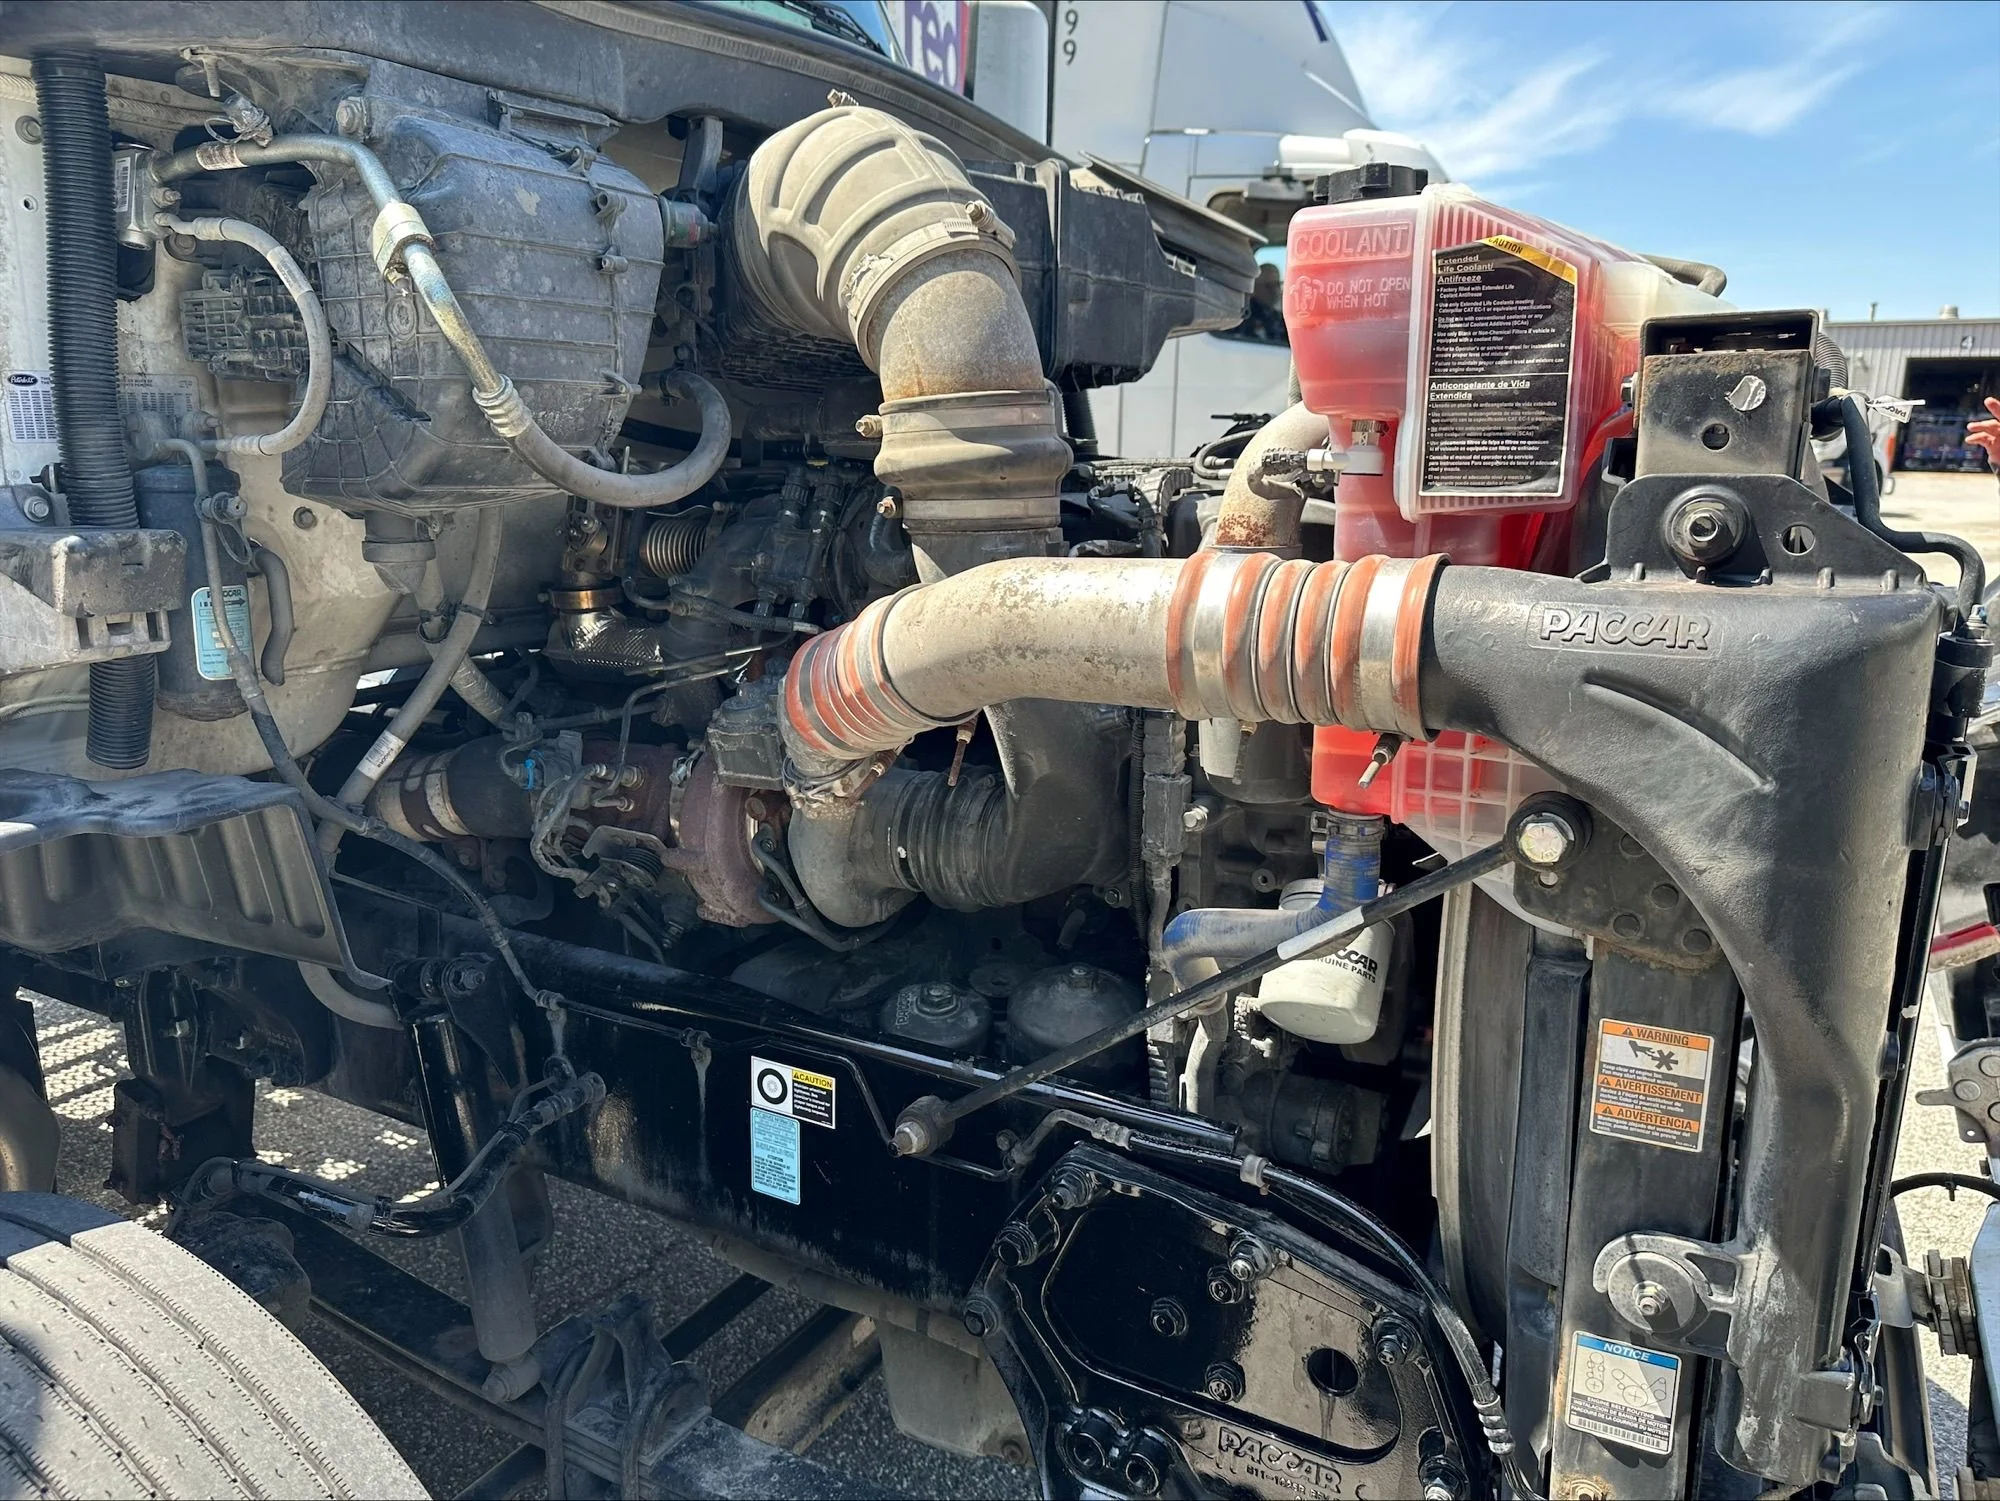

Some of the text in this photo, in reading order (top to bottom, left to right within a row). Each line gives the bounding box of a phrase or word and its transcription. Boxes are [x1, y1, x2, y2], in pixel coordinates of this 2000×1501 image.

[1295, 226, 1409, 258] COOLANT
[1438, 254, 1479, 265] Extended
[1438, 262, 1494, 274] Life Coolant/
[1327, 277, 1411, 295] DO NOT OPEN
[1437, 274, 1482, 285] Antifreeze
[1327, 292, 1389, 309] WHEN HOT
[1961, 335, 1975, 350] 4
[1430, 380, 1530, 390] Anticongelante de Vida
[1430, 391, 1472, 400] Extendida
[1540, 607, 1711, 650] PACCAR
[1335, 947, 1378, 975] CCAR
[1351, 966, 1376, 984] PARTS
[1636, 1028, 1689, 1046] WARNING
[799, 1074, 832, 1088] CAUTION
[1614, 1078, 1701, 1103] AVERTISSEMENT
[1616, 1108, 1692, 1131] ADVERTENCIA
[1603, 1342, 1650, 1361] NOTICE
[1573, 1399, 1608, 1413] INSTALACION
[1617, 1411, 1637, 1421] BANDA
[1646, 1419, 1668, 1430] MOTOR
[1587, 1397, 1655, 1420] ENGINE BELT ROUTING
[1570, 1404, 1597, 1416] PARCOURS
[1647, 1426, 1668, 1437] MOTEUR
[1218, 1426, 1341, 1494] PACCAR
